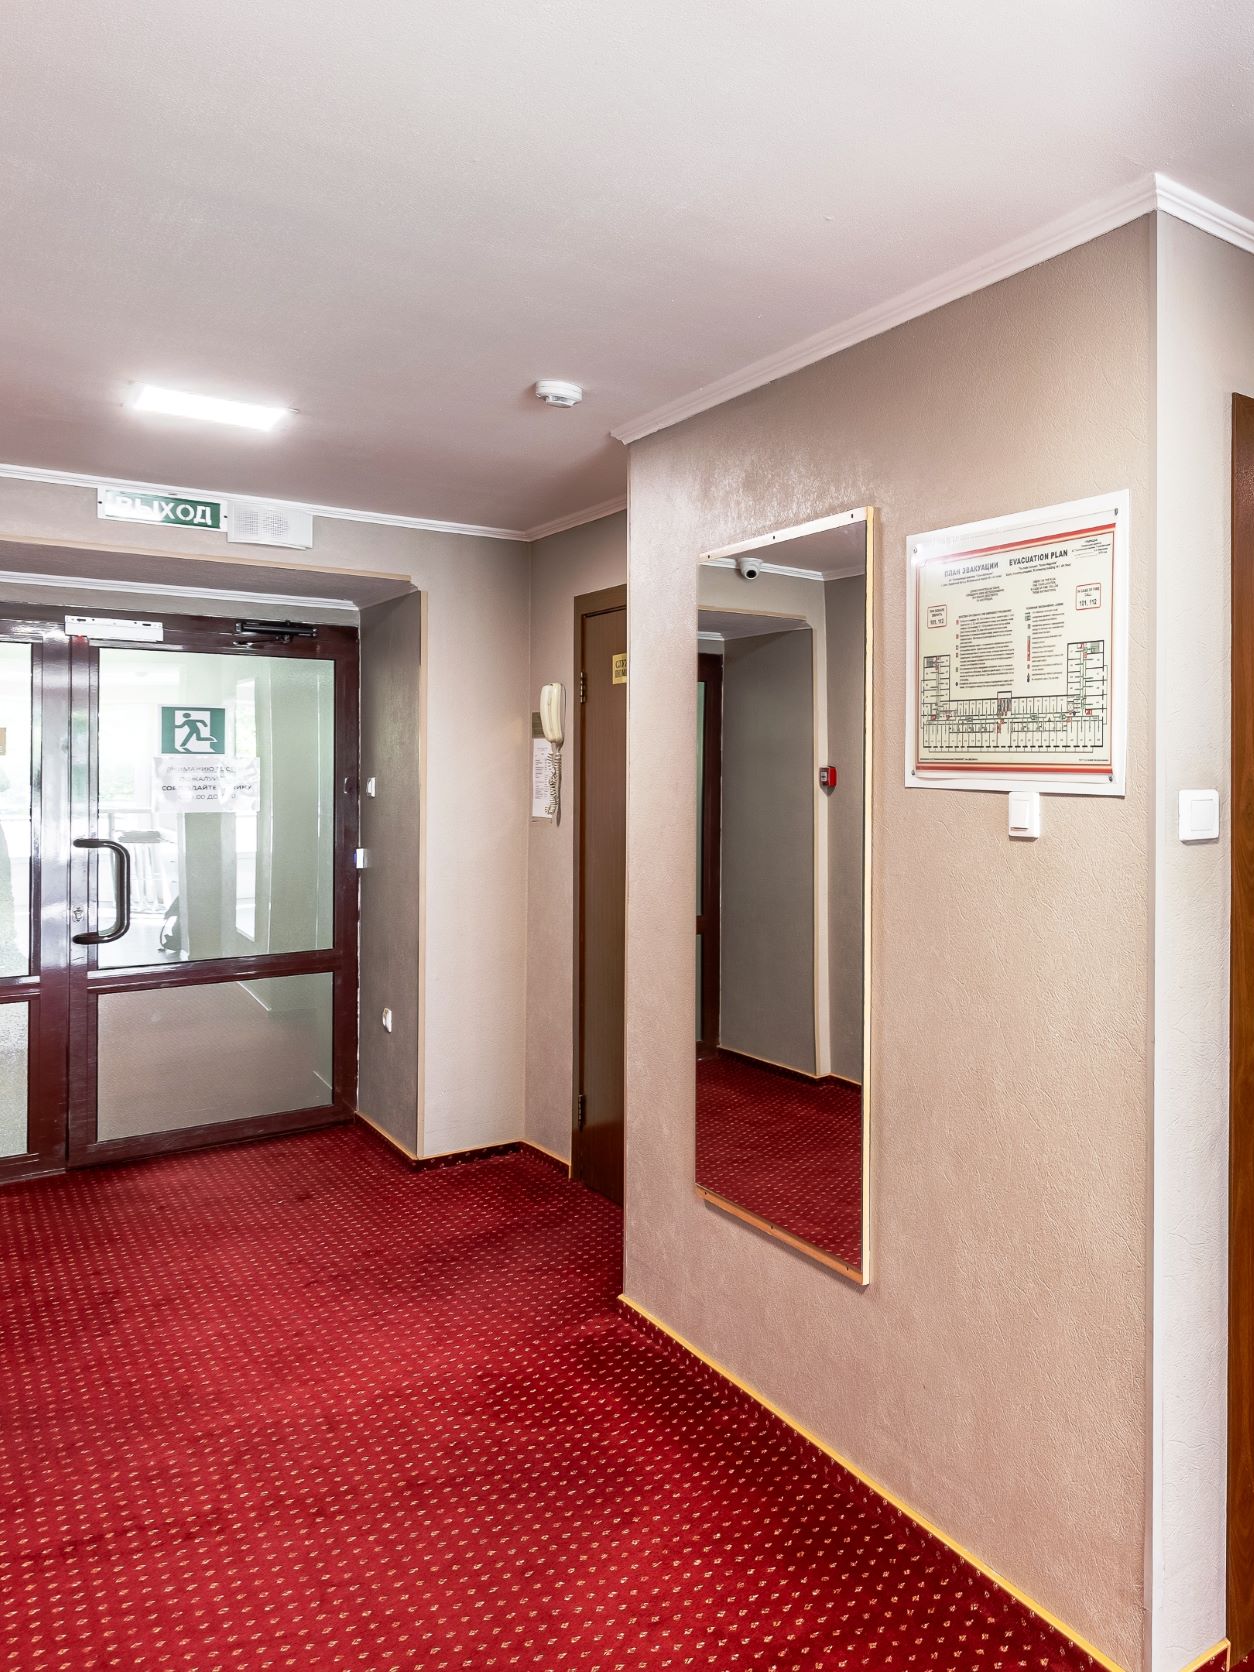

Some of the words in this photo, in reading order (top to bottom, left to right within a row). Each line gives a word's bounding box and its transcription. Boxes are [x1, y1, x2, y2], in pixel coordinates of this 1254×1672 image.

[1009, 552, 1049, 567] EVACUATION
[1050, 549, 1068, 560] PLAN
[944, 568, 961, 578] ПЛАН
